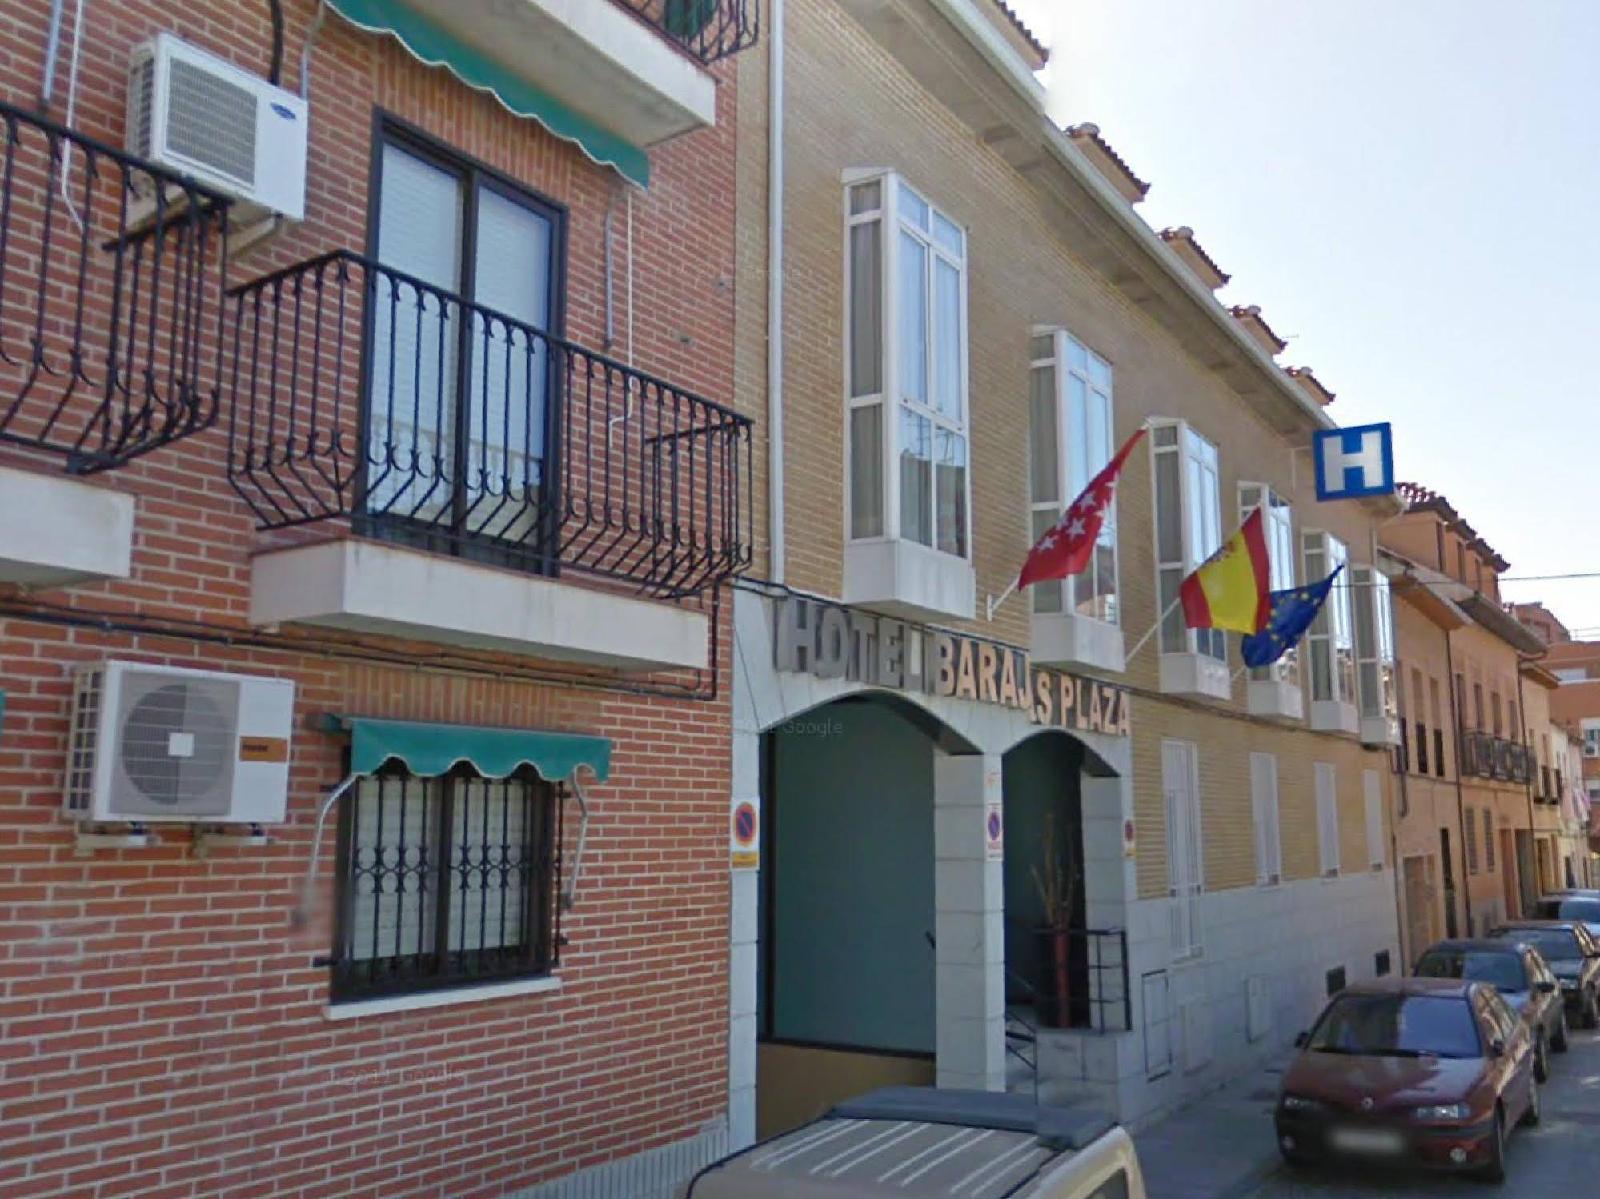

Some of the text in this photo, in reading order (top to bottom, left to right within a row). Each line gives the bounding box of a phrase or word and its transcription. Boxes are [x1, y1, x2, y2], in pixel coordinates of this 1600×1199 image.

[1323, 431, 1384, 492] H
[775, 597, 1131, 737] HOTEL BARAJS PLAZA
